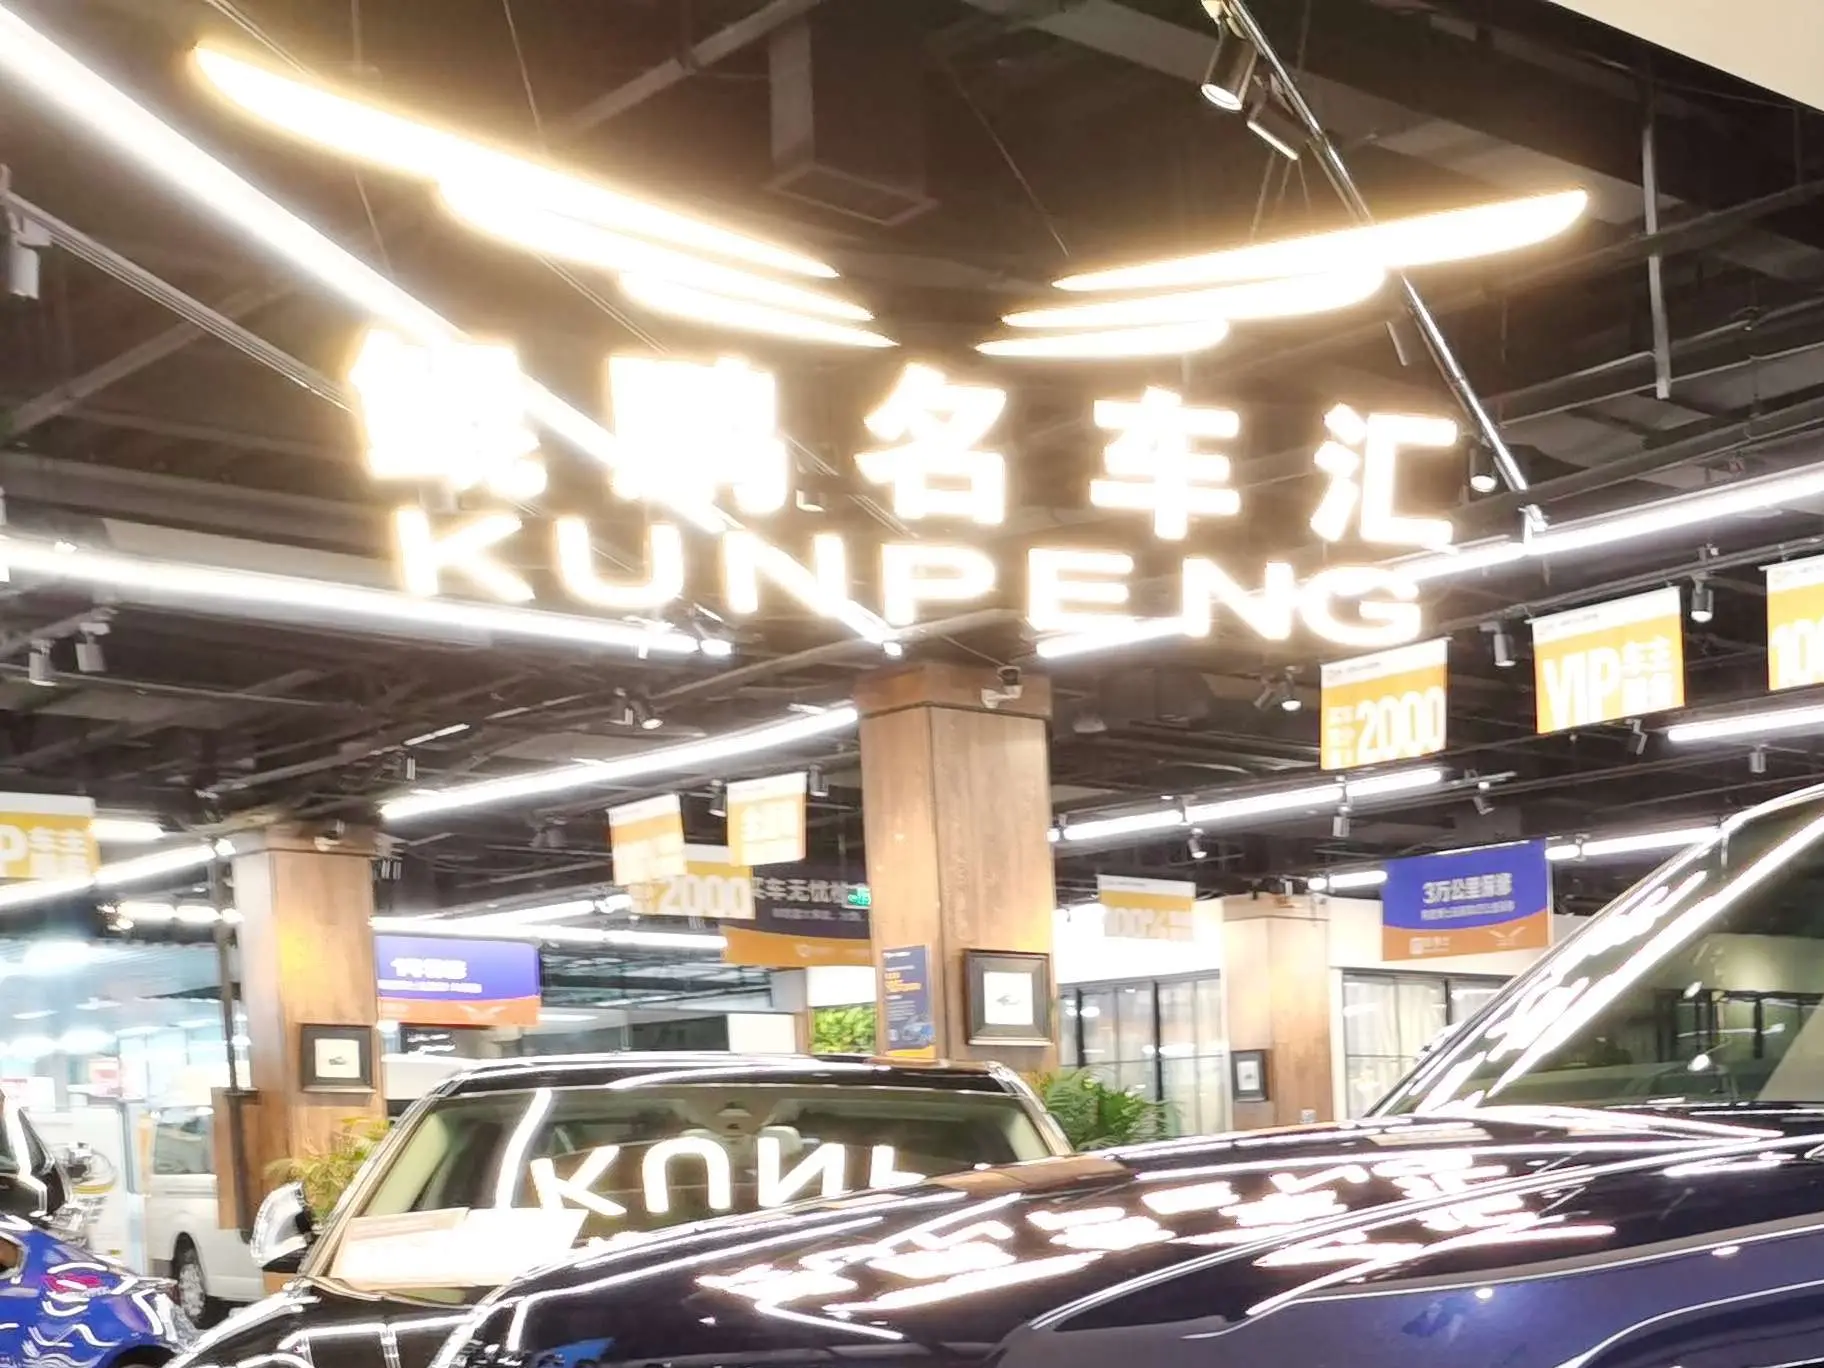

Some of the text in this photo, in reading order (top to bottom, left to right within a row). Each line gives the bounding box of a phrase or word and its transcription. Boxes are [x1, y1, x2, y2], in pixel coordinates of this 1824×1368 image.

[349, 328, 1460, 548] 名车汇
[392, 500, 1424, 648] KUNPENG
[1355, 685, 1447, 763] 2000
[1542, 645, 1621, 731] VIP
